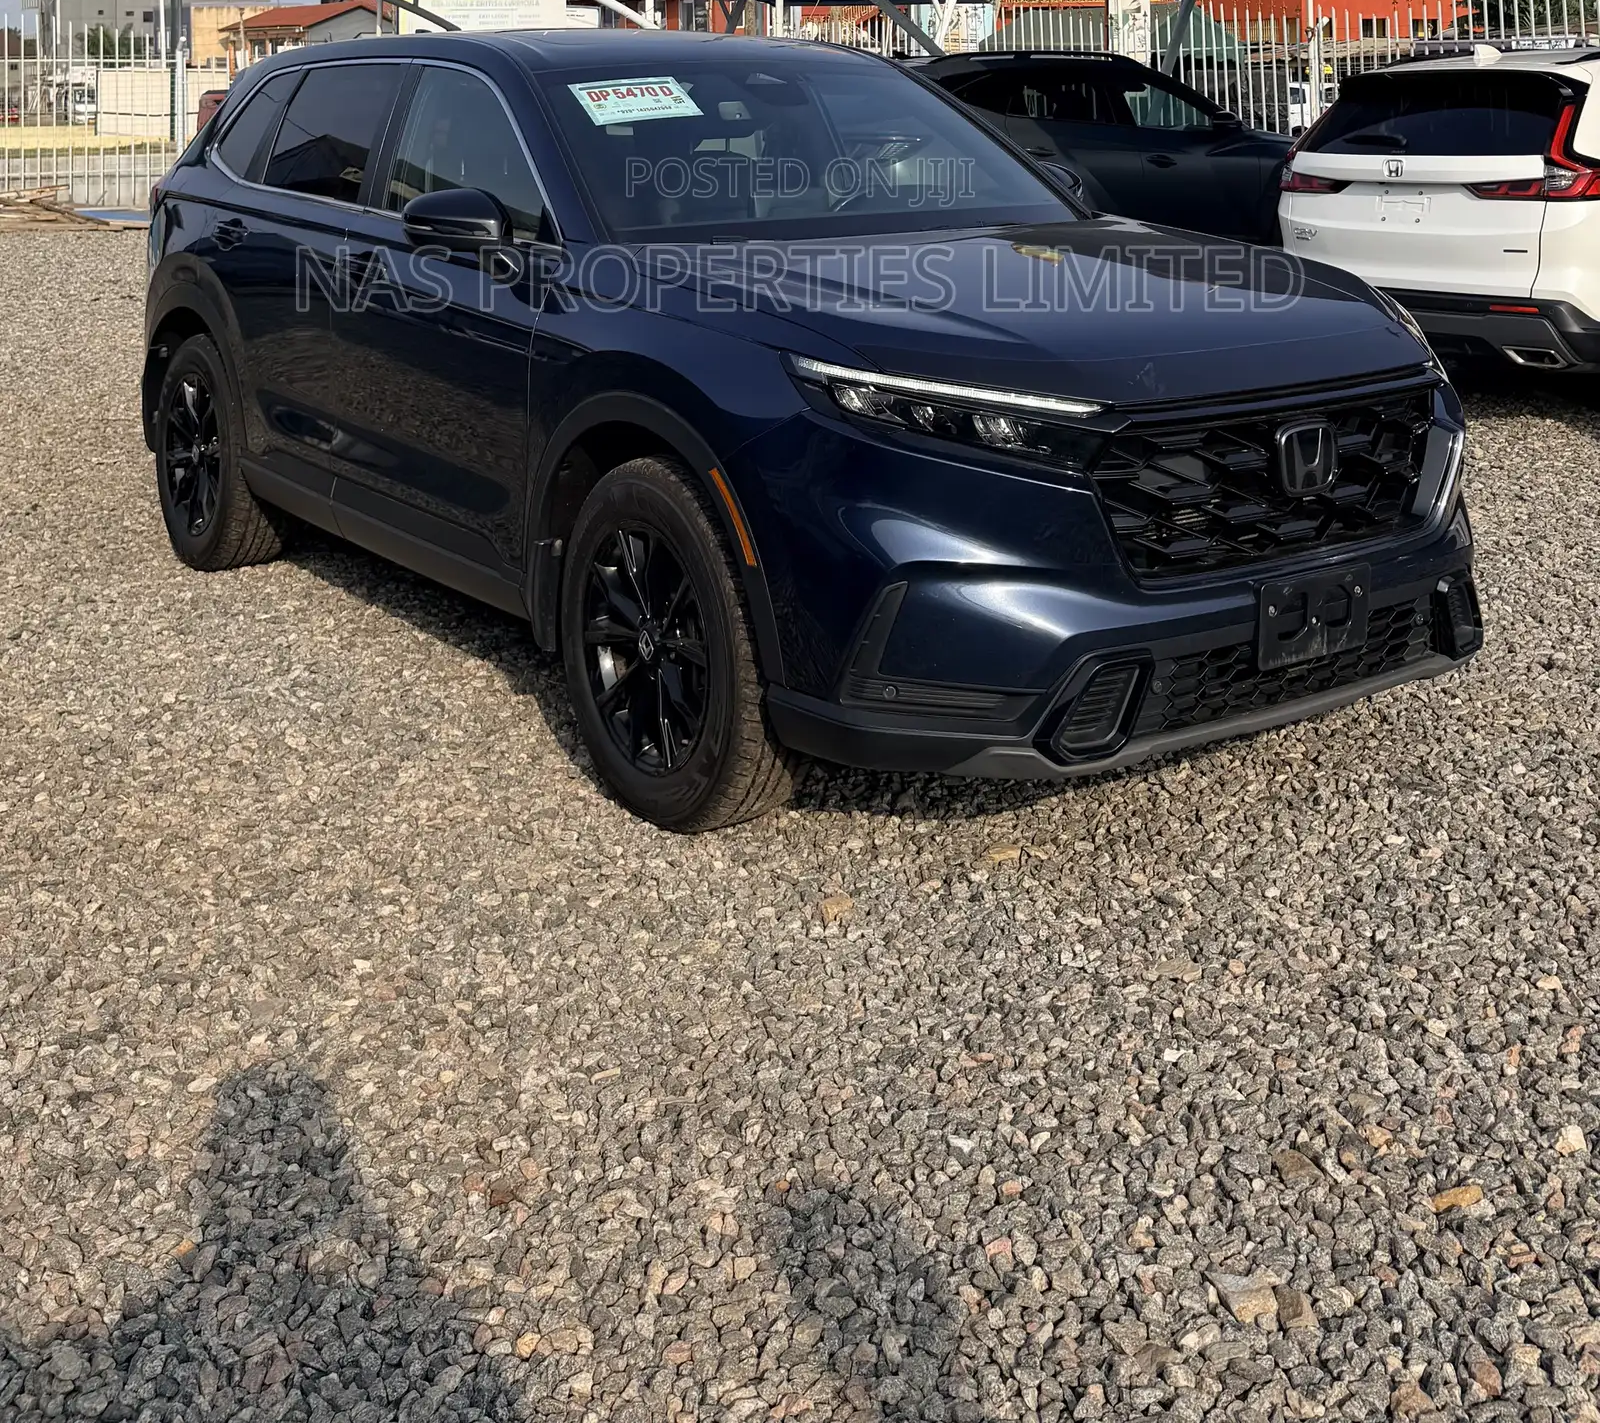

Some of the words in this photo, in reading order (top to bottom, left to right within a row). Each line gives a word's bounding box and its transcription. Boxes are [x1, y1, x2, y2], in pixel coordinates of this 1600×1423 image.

[586, 90, 611, 103] DP
[611, 86, 659, 100] 5470
[657, 85, 674, 97] D
